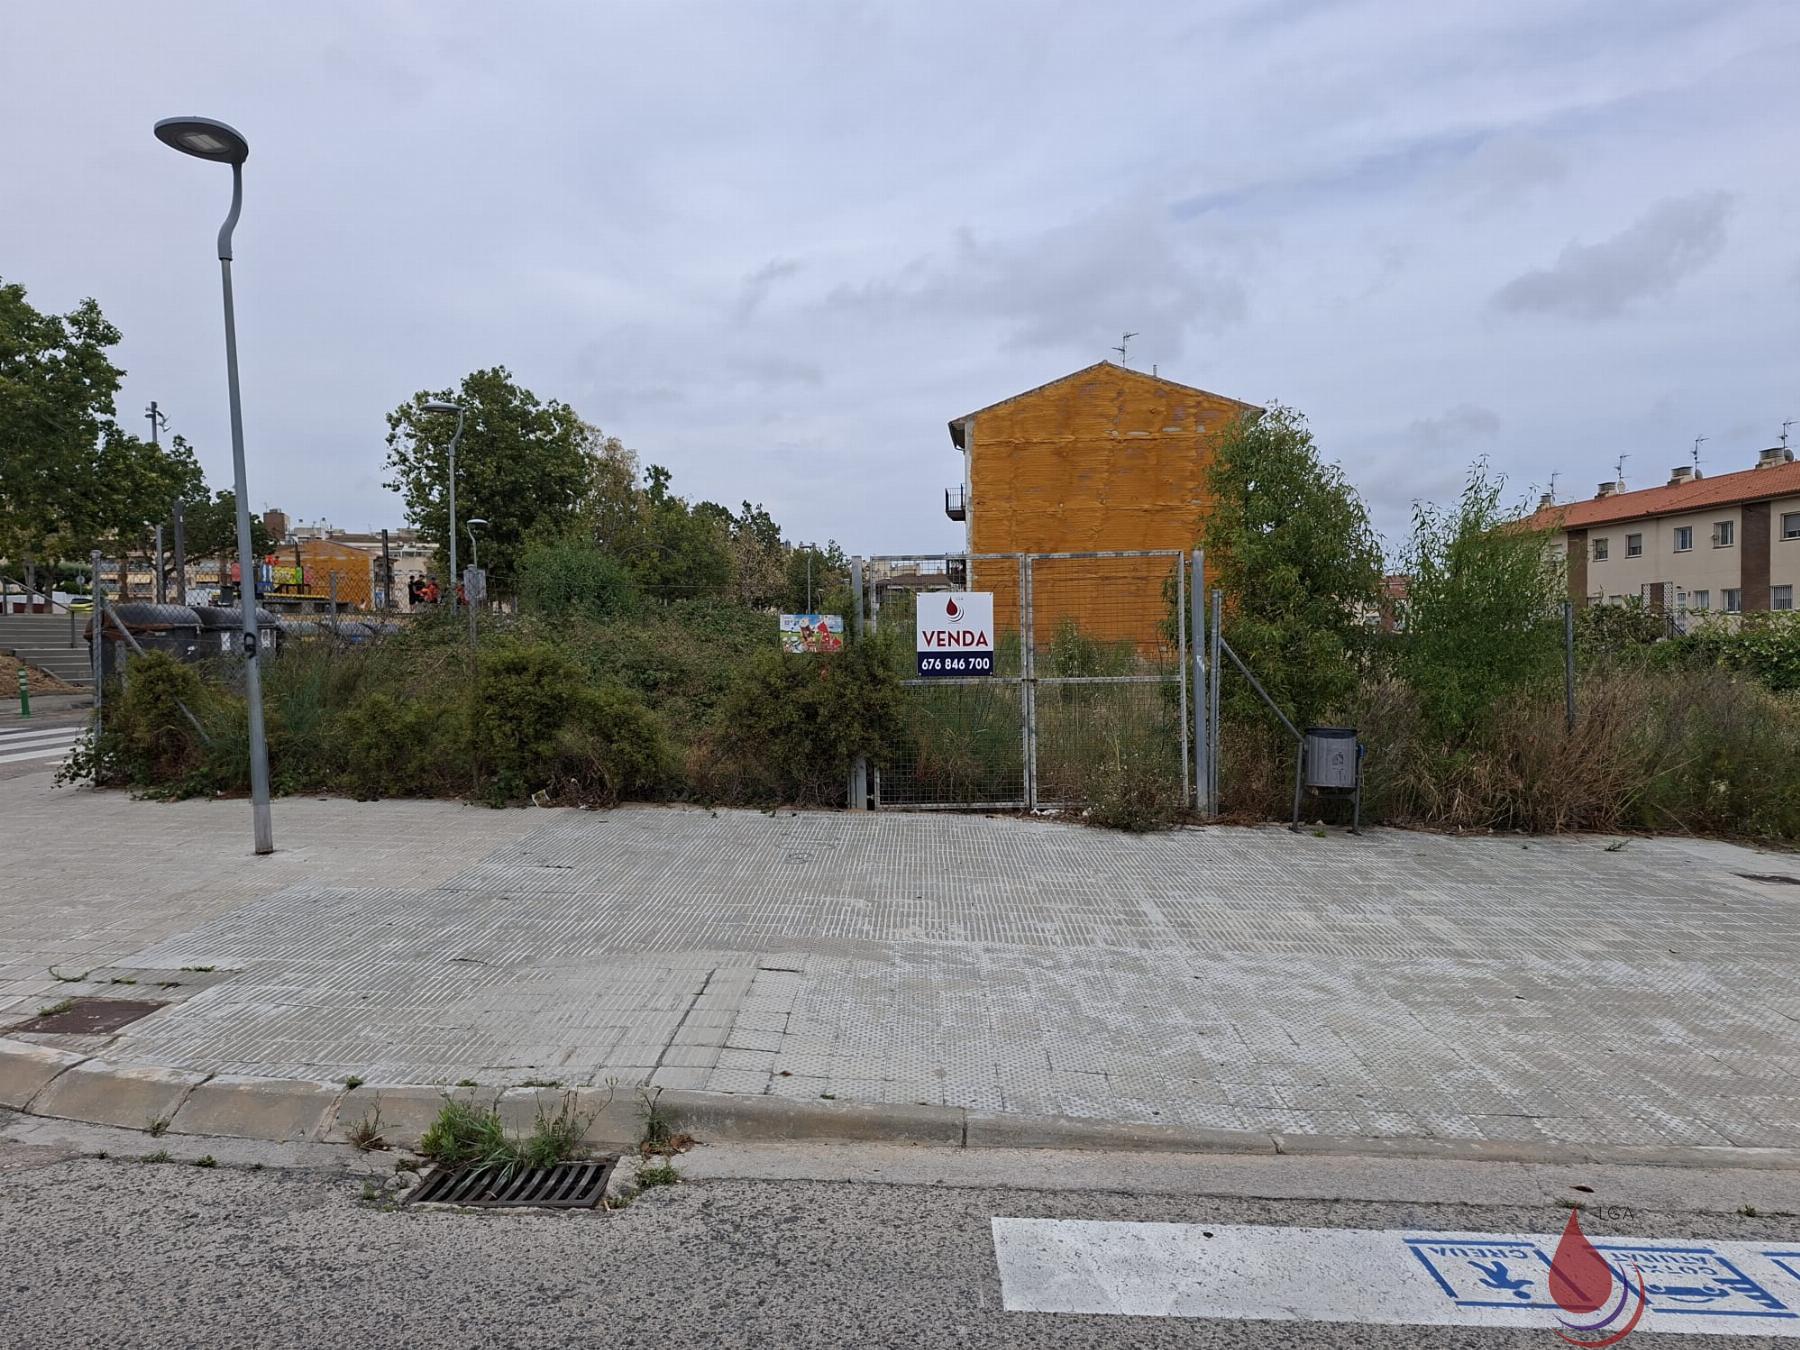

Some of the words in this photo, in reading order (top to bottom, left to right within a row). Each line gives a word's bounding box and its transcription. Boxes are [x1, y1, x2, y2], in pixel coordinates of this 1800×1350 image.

[922, 630, 988, 647] VENDA
[921, 658, 942, 670] 676
[944, 658, 965, 670] 846
[968, 657, 990, 670] 700
[1427, 1247, 1528, 1259] CREUA
